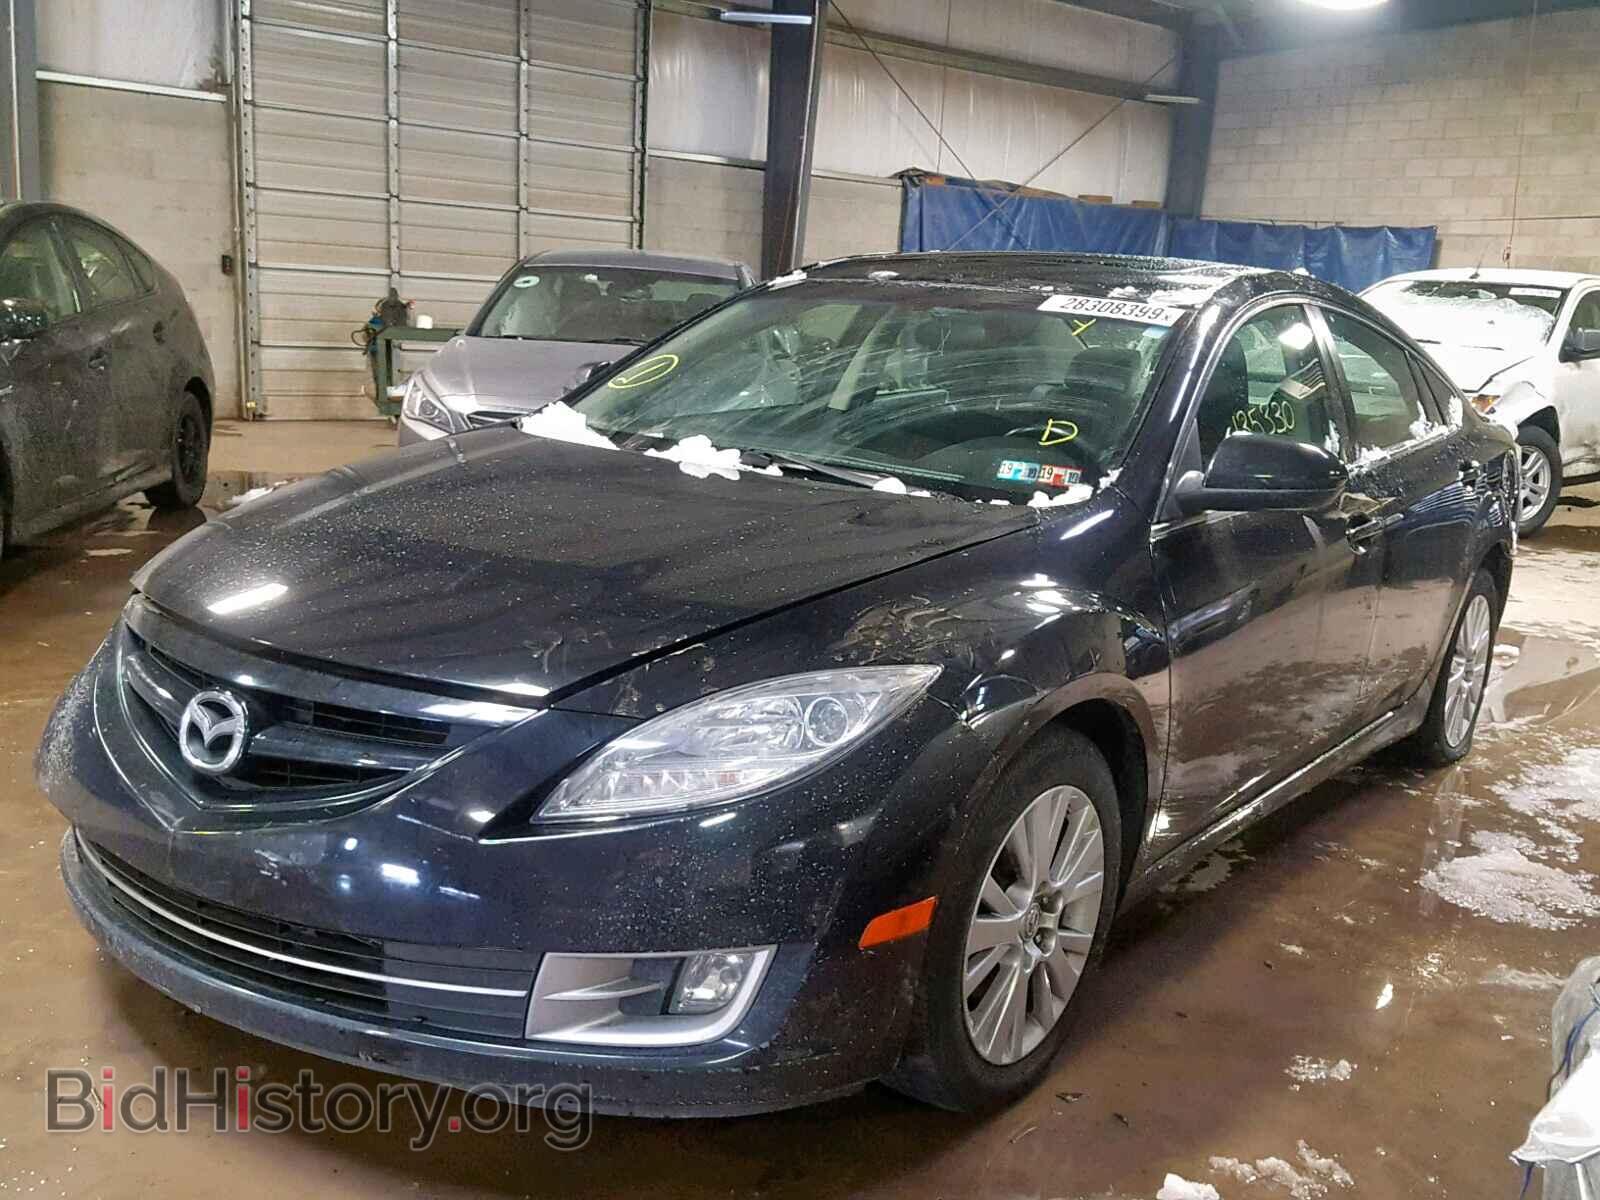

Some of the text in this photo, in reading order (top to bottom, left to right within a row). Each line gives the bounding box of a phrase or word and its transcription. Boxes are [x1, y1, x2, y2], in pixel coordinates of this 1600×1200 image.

[1059, 297, 1165, 320] 28308399
[1039, 418, 1078, 446] D
[1040, 466, 1054, 480] 19
